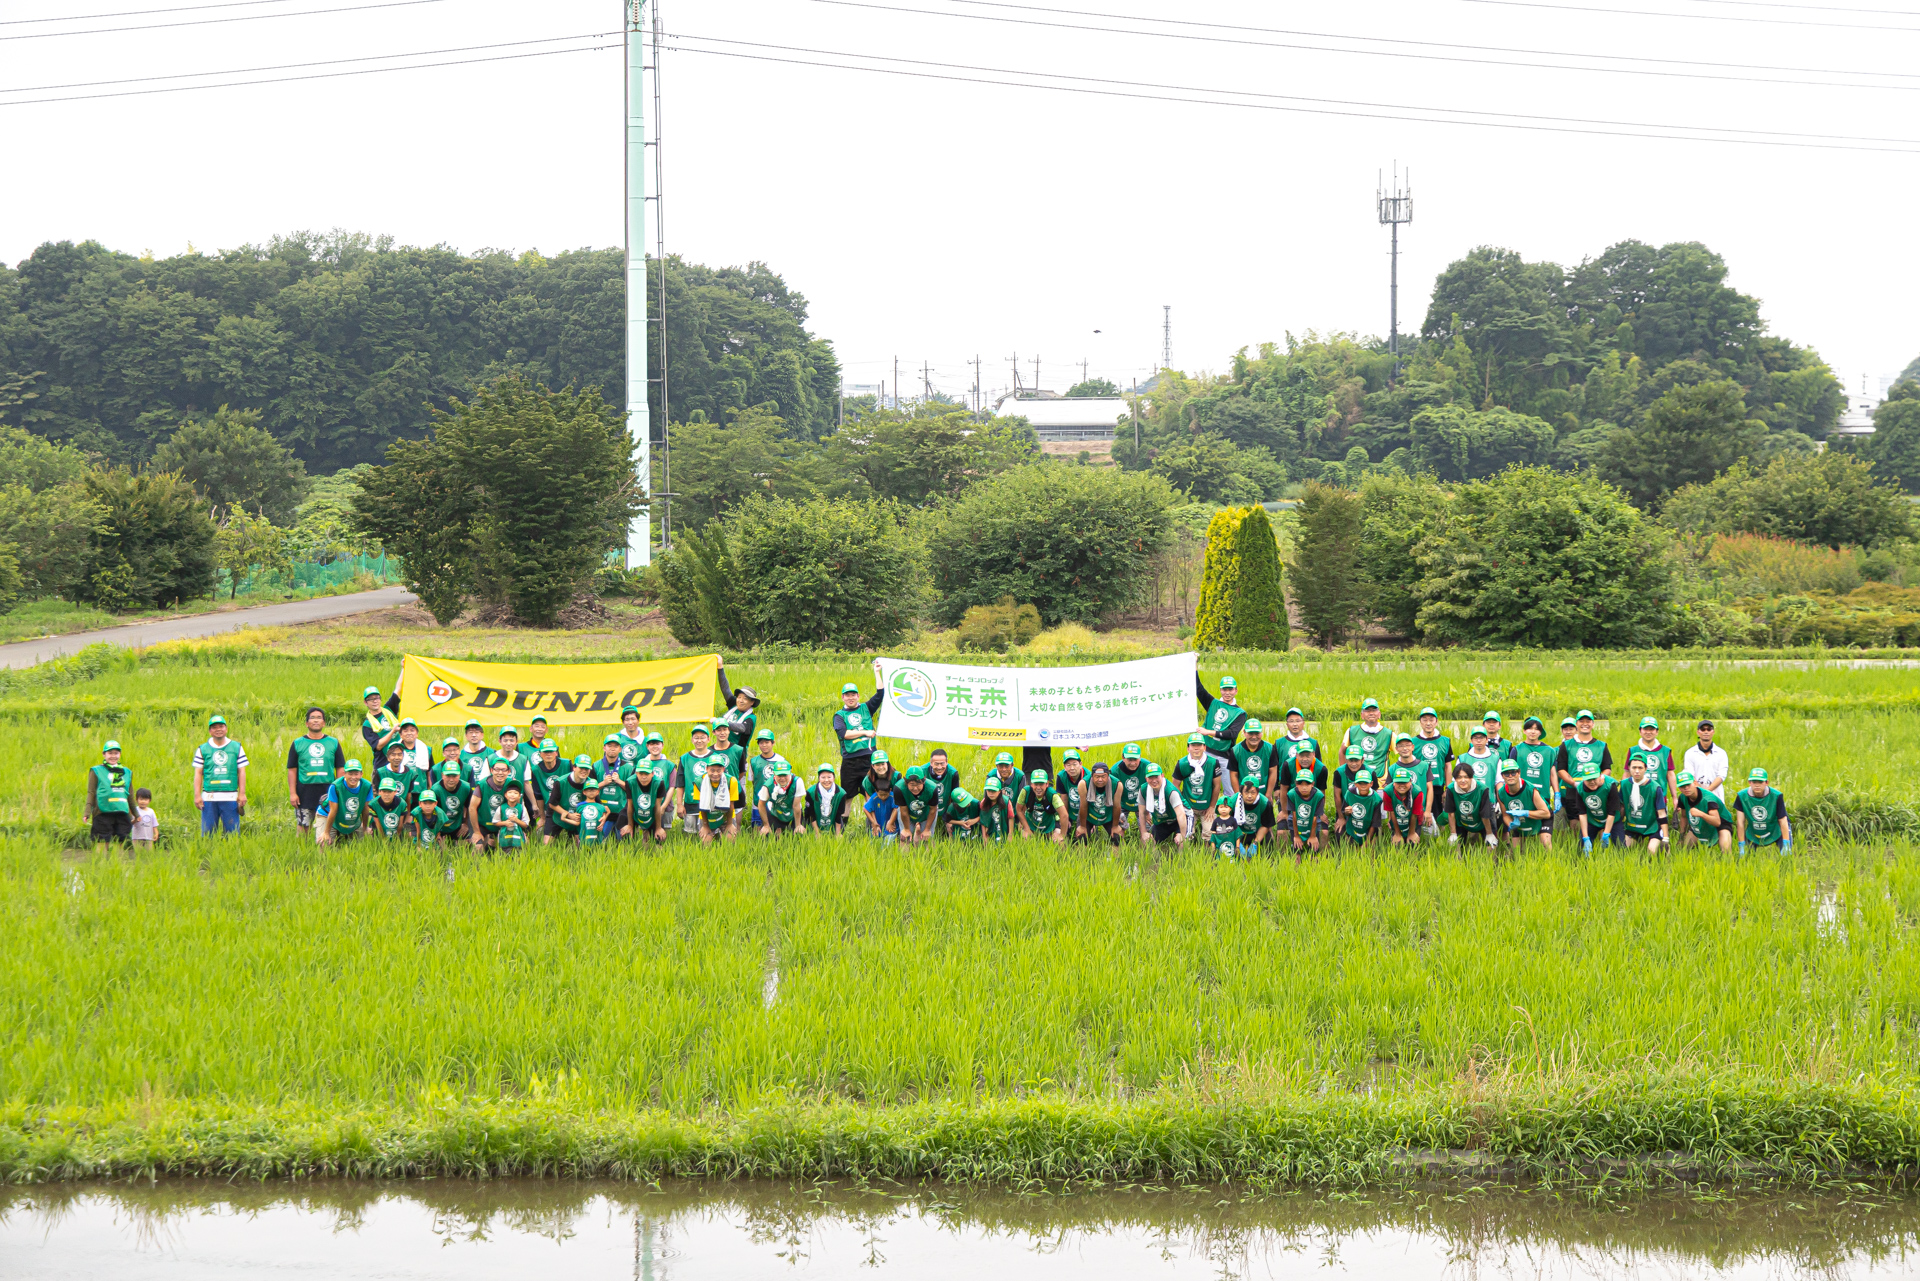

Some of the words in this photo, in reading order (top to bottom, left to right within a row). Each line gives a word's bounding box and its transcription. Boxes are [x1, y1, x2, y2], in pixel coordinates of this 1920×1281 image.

[431, 686, 450, 697] D
[946, 685, 1007, 706] 未来
[1029, 680, 1142, 696] 未来の子どもたちのために、
[467, 682, 694, 712] DUNLOP
[1029, 689, 1188, 712] 大切な自然を守る活動を行っています。
[946, 705, 1008, 719] プロジェクト
[1053, 730, 1109, 740] 日本ユネスコ協会連盟
